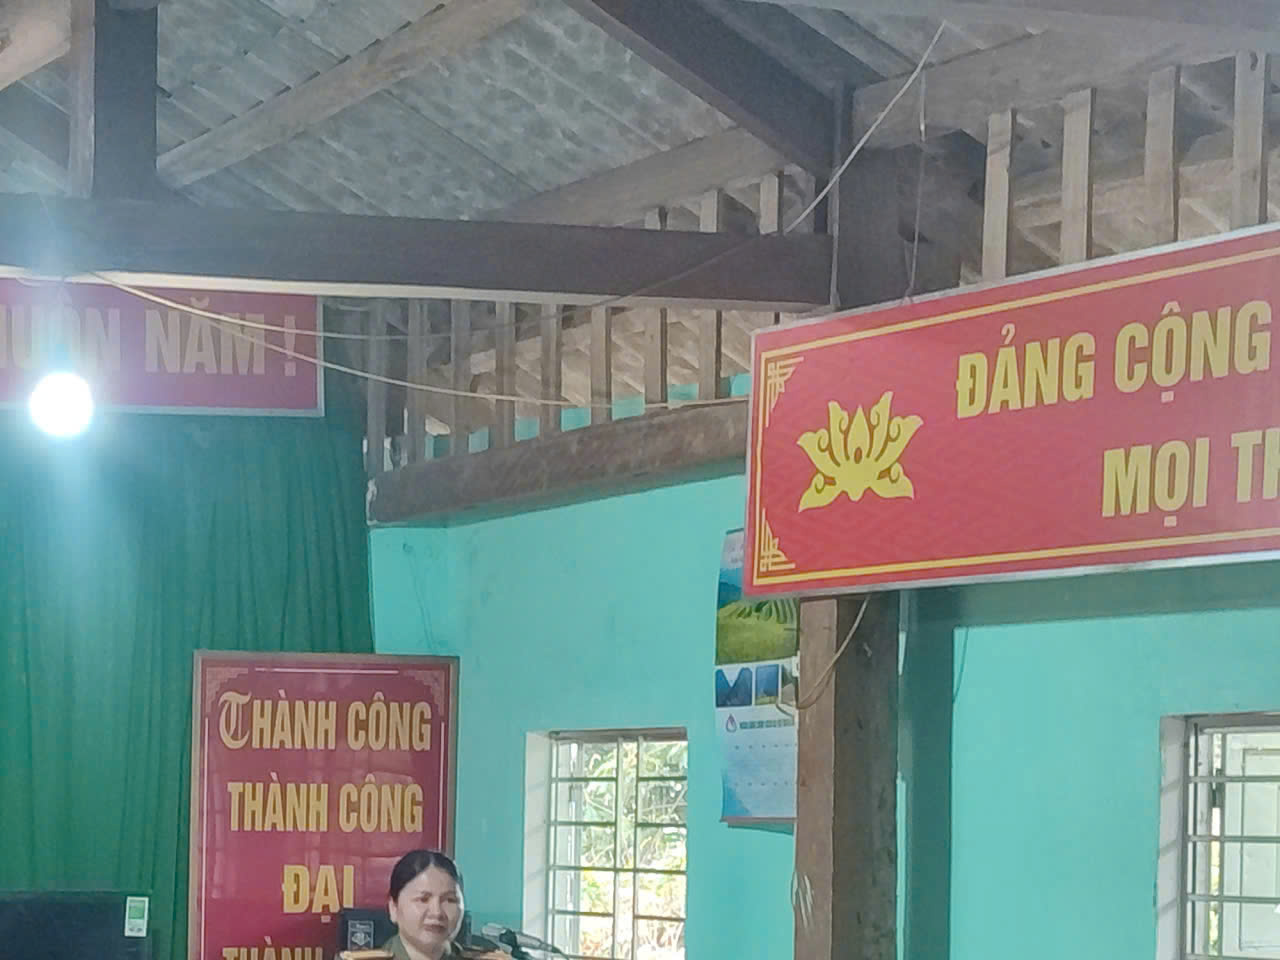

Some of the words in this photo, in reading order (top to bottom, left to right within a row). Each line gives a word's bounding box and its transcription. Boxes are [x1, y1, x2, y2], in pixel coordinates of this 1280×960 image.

[144, 297, 265, 376] NĂM
[956, 323, 1097, 419] ĐẢNG
[1114, 300, 1273, 402] CỘNG
[1101, 437, 1211, 527] MỌI
[219, 689, 336, 751] THÀNH
[346, 692, 432, 752] CÔNG
[227, 772, 329, 832] THÀNH
[338, 774, 424, 833] CÔNG
[281, 864, 355, 923] ĐẠI
